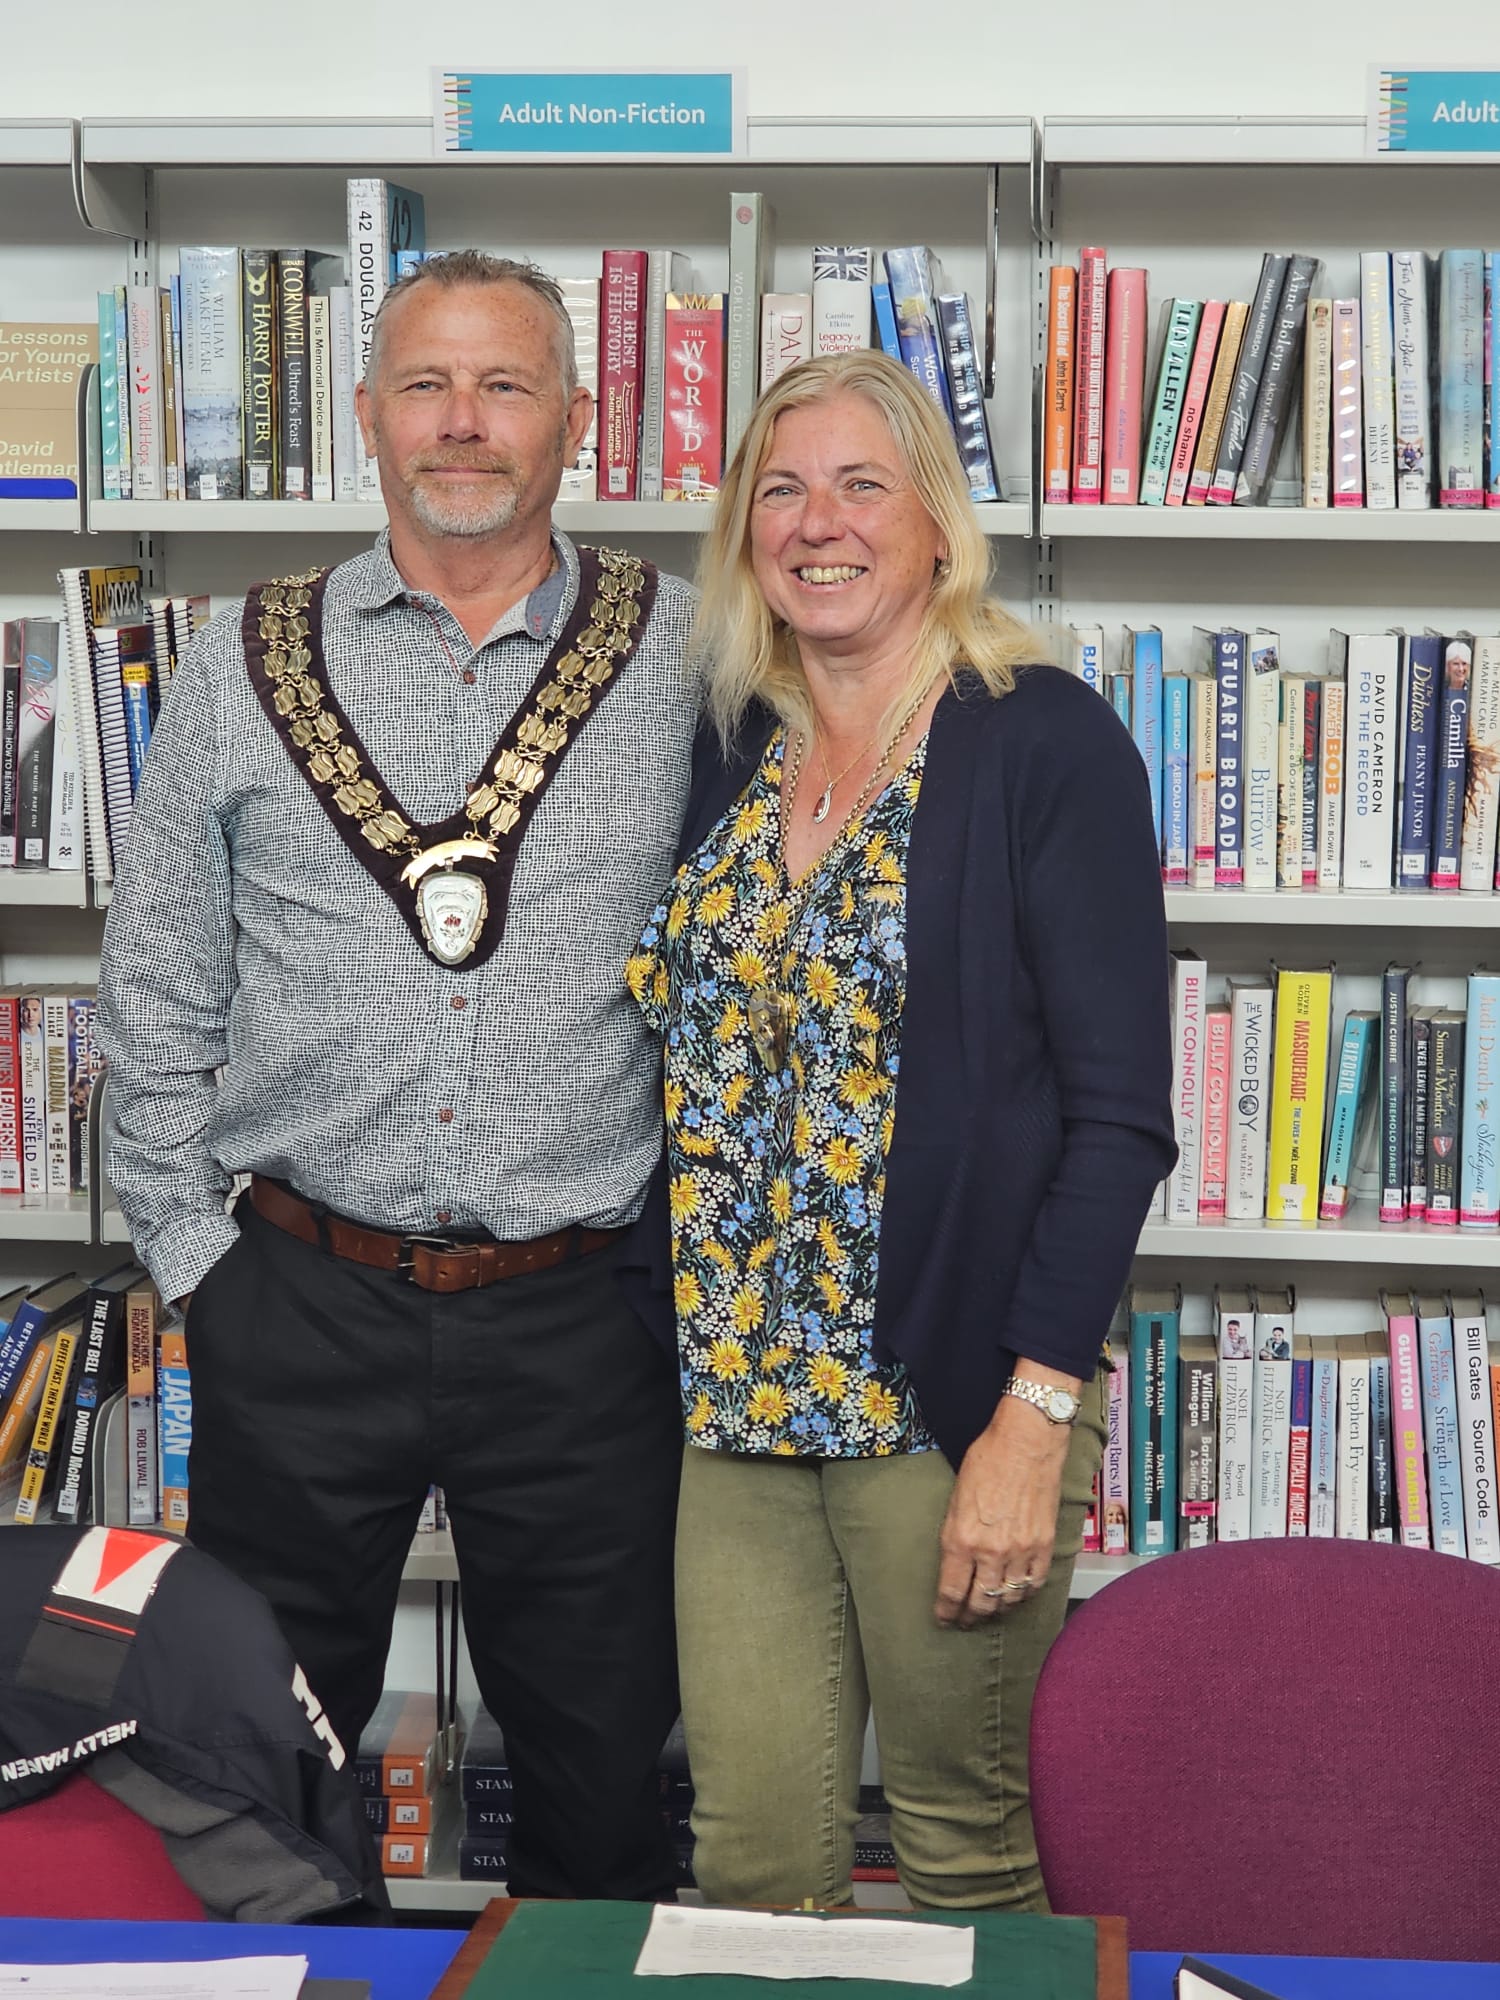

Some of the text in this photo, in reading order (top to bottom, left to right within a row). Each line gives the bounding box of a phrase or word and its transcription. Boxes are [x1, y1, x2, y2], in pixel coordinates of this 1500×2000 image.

[498, 103, 706, 124] Adult Non-Fiction
[1432, 100, 1500, 123] Adult
[359, 210, 372, 231] 42
[314, 301, 323, 324] This
[360, 243, 375, 335] DOUGLAS
[624, 272, 637, 312] THE
[1399, 289, 1415, 326] Mums
[0, 329, 88, 345] Lessons
[200, 278, 212, 374] SHAKESPEARE
[213, 294, 224, 359] WILLIAM
[315, 326, 323, 336] Is
[608, 266, 622, 376] IS HISTORY
[623, 319, 637, 369] REST
[730, 272, 743, 387] WORLD HISTORY
[819, 333, 852, 343] Legacy
[819, 343, 861, 352] Violence
[1271, 271, 1305, 372] Anne Boleyn
[0, 366, 73, 383] Artists
[24, 348, 90, 368] Young
[252, 302, 273, 444] HARRY POTTER
[282, 267, 305, 449] CORNWELL Uhtred's Feast
[315, 339, 325, 389] Memorial
[1228, 278, 1276, 460] PAMELA ANDERSON Love, Pamela
[317, 391, 325, 427] Device
[1055, 387, 1066, 412] Carré
[1177, 321, 1216, 470] TOM ALLEN no shame
[0, 459, 77, 476] ntleman
[1369, 426, 1378, 465] BEENY
[1380, 424, 1389, 465] SARAH
[107, 579, 138, 618] 2023
[25, 654, 52, 721] CHER
[1083, 645, 1101, 690] BJÖ
[1411, 661, 1433, 734] Duchess
[6, 711, 14, 730] BUSH
[1476, 659, 1489, 742] MARIAH CAREY
[5, 759, 12, 769] TO
[1220, 642, 1237, 848] STUART BROAD
[1289, 689, 1297, 826] Confessions BOOKSELLER
[1325, 687, 1341, 795] NAMED BOB
[1357, 672, 1371, 817] FOR THE RECORD
[1372, 675, 1385, 814] DAVID CAMERON
[1447, 699, 1466, 769] Camilla
[3, 781, 11, 816] INVISIBLE
[5, 771, 12, 780] BE
[1172, 764, 1182, 849] ABROAD JAPA
[1412, 744, 1426, 838] PENNY JUNOR
[1447, 779, 1456, 819] ANGELA
[1250, 768, 1271, 852] Burrow
[1266, 790, 1276, 831] Lindsey
[1184, 977, 1199, 1022] BILLY
[25, 1042, 33, 1088] EXTRA MILE
[74, 1006, 88, 1081] FOOTBALL
[1181, 1026, 1197, 1120] CONNOLLY
[1239, 1002, 1262, 1132] THE WICKED BOY
[1290, 1020, 1310, 1102] MASQUERADE
[1338, 1041, 1359, 1096] BIRDGIRL
[1417, 1040, 1427, 1066] NEVER
[1436, 1031, 1449, 1064] Simon
[1477, 994, 1496, 1092] Judi Dench
[47, 1046, 66, 1114] MARADONA
[1207, 1023, 1225, 1178] BILLY CONNOLLY
[1389, 992, 1398, 1185] JUSTIN CURRIE THE TREMOLO DIARIES
[1417, 1069, 1427, 1094] LEAVE
[24, 1096, 37, 1161] SINFIELD
[1415, 1125, 1425, 1155] BEHIND
[1416, 1104, 1426, 1123] MAN
[8, 1321, 34, 1369] BETWEEN
[131, 1308, 141, 1374] FROM MONGOLIA
[141, 1308, 150, 1368] WALKING HOME
[1428, 1332, 1442, 1400] Garraway
[1467, 1327, 1483, 1401] Bill Gates
[37, 1338, 70, 1446] COFFEE FIRST, THEN THE WORLD
[72, 1299, 109, 1454] THE LAST BELL DONALD
[1145, 1348, 1154, 1407] MUM DAD
[1156, 1338, 1166, 1416] HITLER, STALIN
[1188, 1368, 1201, 1427] Finnegan
[1201, 1372, 1213, 1422] William
[1225, 1365, 1237, 1445] FITZPATRICK
[1238, 1388, 1247, 1421] NOEL
[1262, 1366, 1274, 1446] FITZPATRICK
[1275, 1390, 1285, 1422] NOEL
[164, 1370, 192, 1456] JAPAN
[1346, 1377, 1364, 1472] Stephen Fry
[1397, 1334, 1421, 1523] GLUTTON ED GAMBLE
[136, 1428, 147, 1489] ROB LILWALL
[1109, 1398, 1122, 1498] Vanessa Bares All
[1144, 1441, 1153, 1504] FINKELSTEIN
[1156, 1454, 1165, 1491] DANIEL
[1200, 1436, 1212, 1499] Barbarian
[1433, 1406, 1453, 1526] Strength of Love
[1472, 1419, 1488, 1474] Source
[1224, 1460, 1234, 1501] Supervet
[1236, 1463, 1246, 1497] Beyond
[1, 1719, 138, 1782] HELLY HANEN
